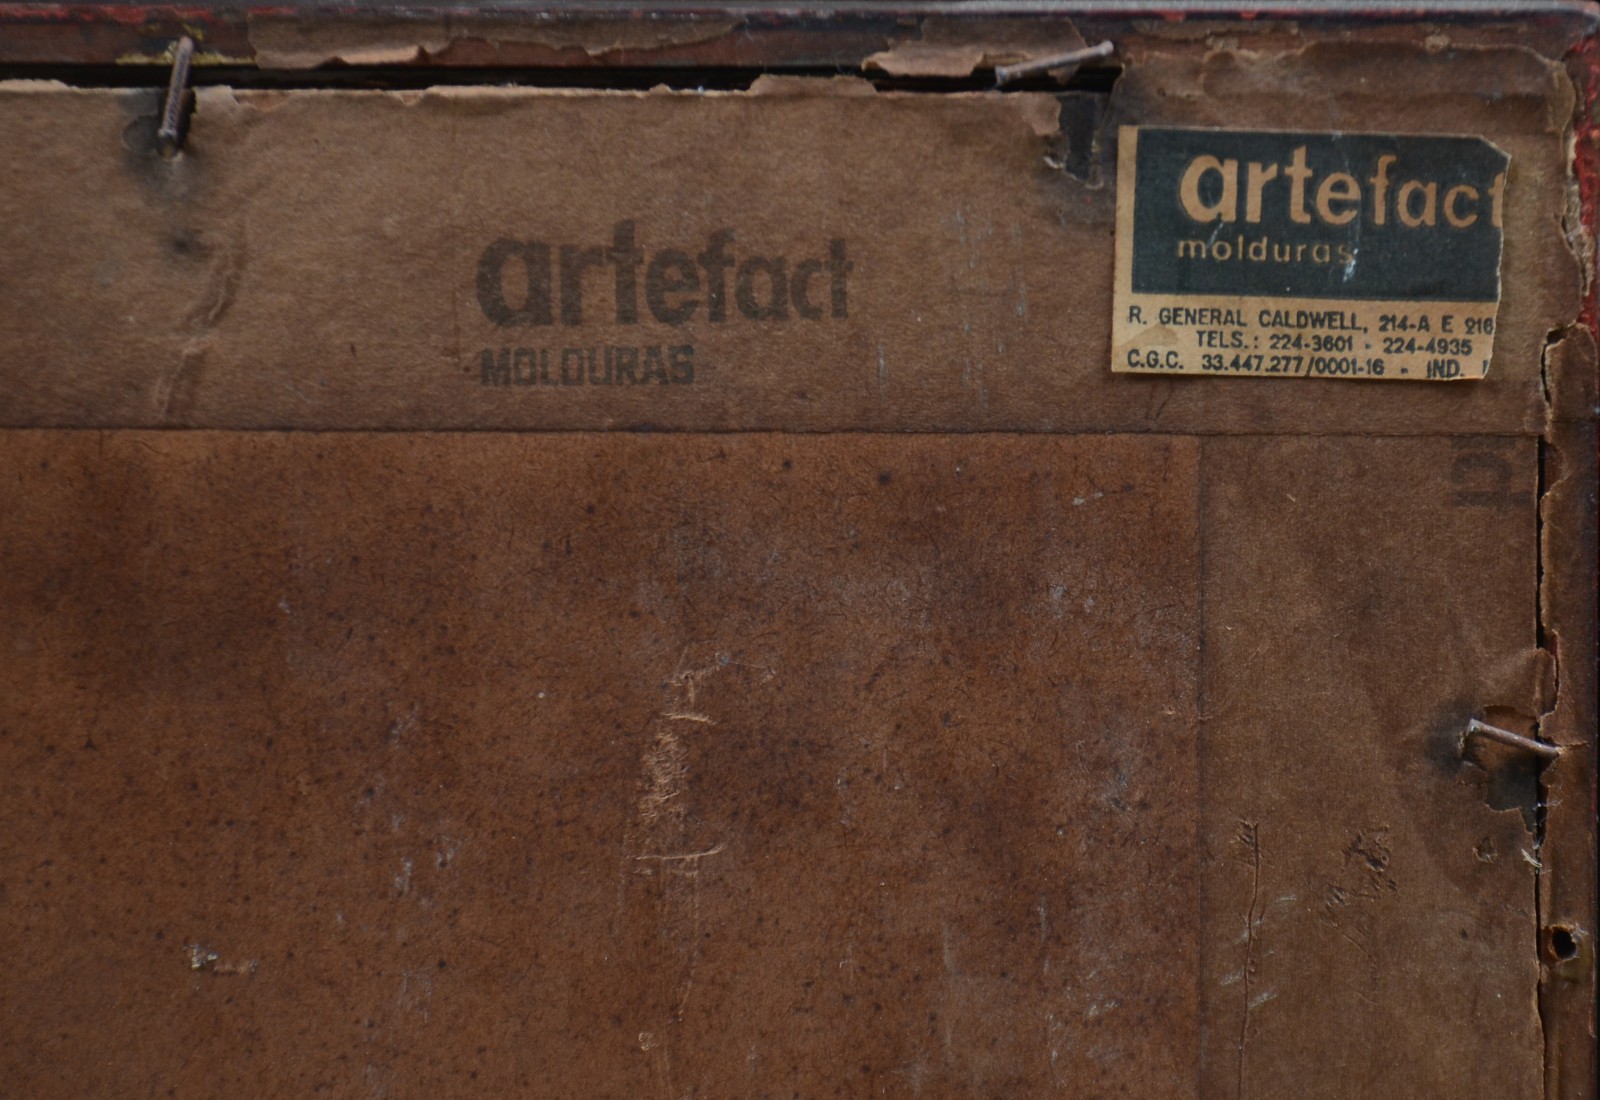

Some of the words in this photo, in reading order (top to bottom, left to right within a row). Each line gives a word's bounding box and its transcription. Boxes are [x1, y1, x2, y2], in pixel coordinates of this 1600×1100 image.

[1179, 144, 1505, 229] artefact
[1177, 234, 1354, 264] molduras
[476, 219, 854, 327] artefact
[1128, 305, 1147, 325] R.
[1158, 307, 1247, 326] GENERAL
[1258, 309, 1368, 334] CALDWELL,
[1378, 314, 1430, 333] 214-A
[1441, 315, 1453, 333] E
[1465, 316, 1493, 334] 216
[1269, 333, 1353, 352] 224-3601
[1383, 336, 1473, 356] 224-4935
[1127, 349, 1184, 370] C.G.C.
[1201, 353, 1385, 377] 33.447.277/0001-16
[1427, 358, 1466, 379] IND.
